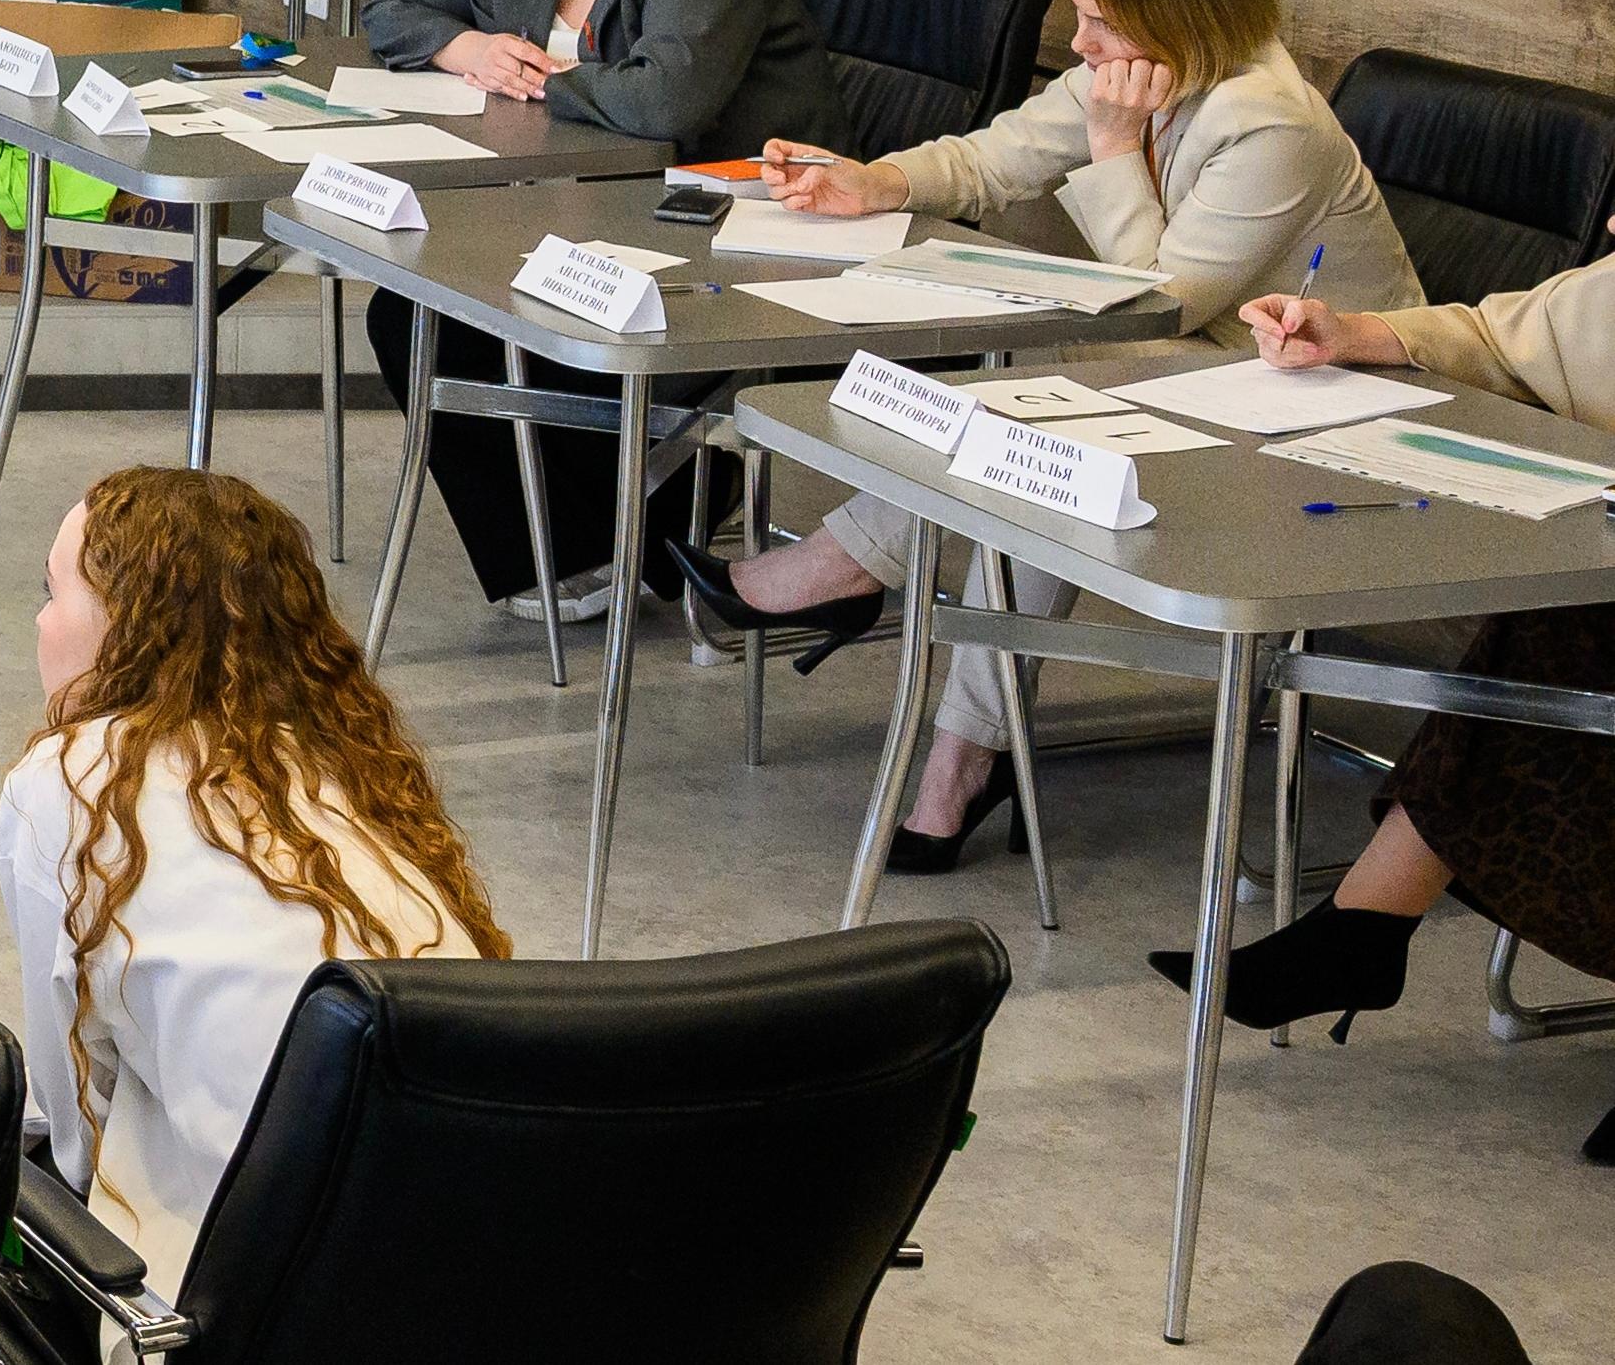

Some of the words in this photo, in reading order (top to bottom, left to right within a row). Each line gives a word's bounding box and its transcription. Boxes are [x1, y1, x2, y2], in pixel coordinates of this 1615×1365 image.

[306, 178, 386, 216] СОБСТВЕННОСТЬ
[320, 165, 391, 198] ДОВЕРЯЮЩИЕ
[556, 265, 618, 297] АНАСТАСИЯ
[568, 247, 624, 280] ВАСИЛЬЕВА
[540, 276, 610, 314] НИКОЛАЕВНА
[857, 360, 965, 416] НАПРАВЛЯЮЩИЕ
[849, 381, 870, 403] НА
[868, 389, 953, 435] ПЕРЕГОВОРЫ
[1006, 425, 1084, 463] ПУТИЛОВА
[1005, 448, 1074, 482] НАТАЛЬЯ
[983, 464, 1080, 509] ВИТАЛЬЕВНА
